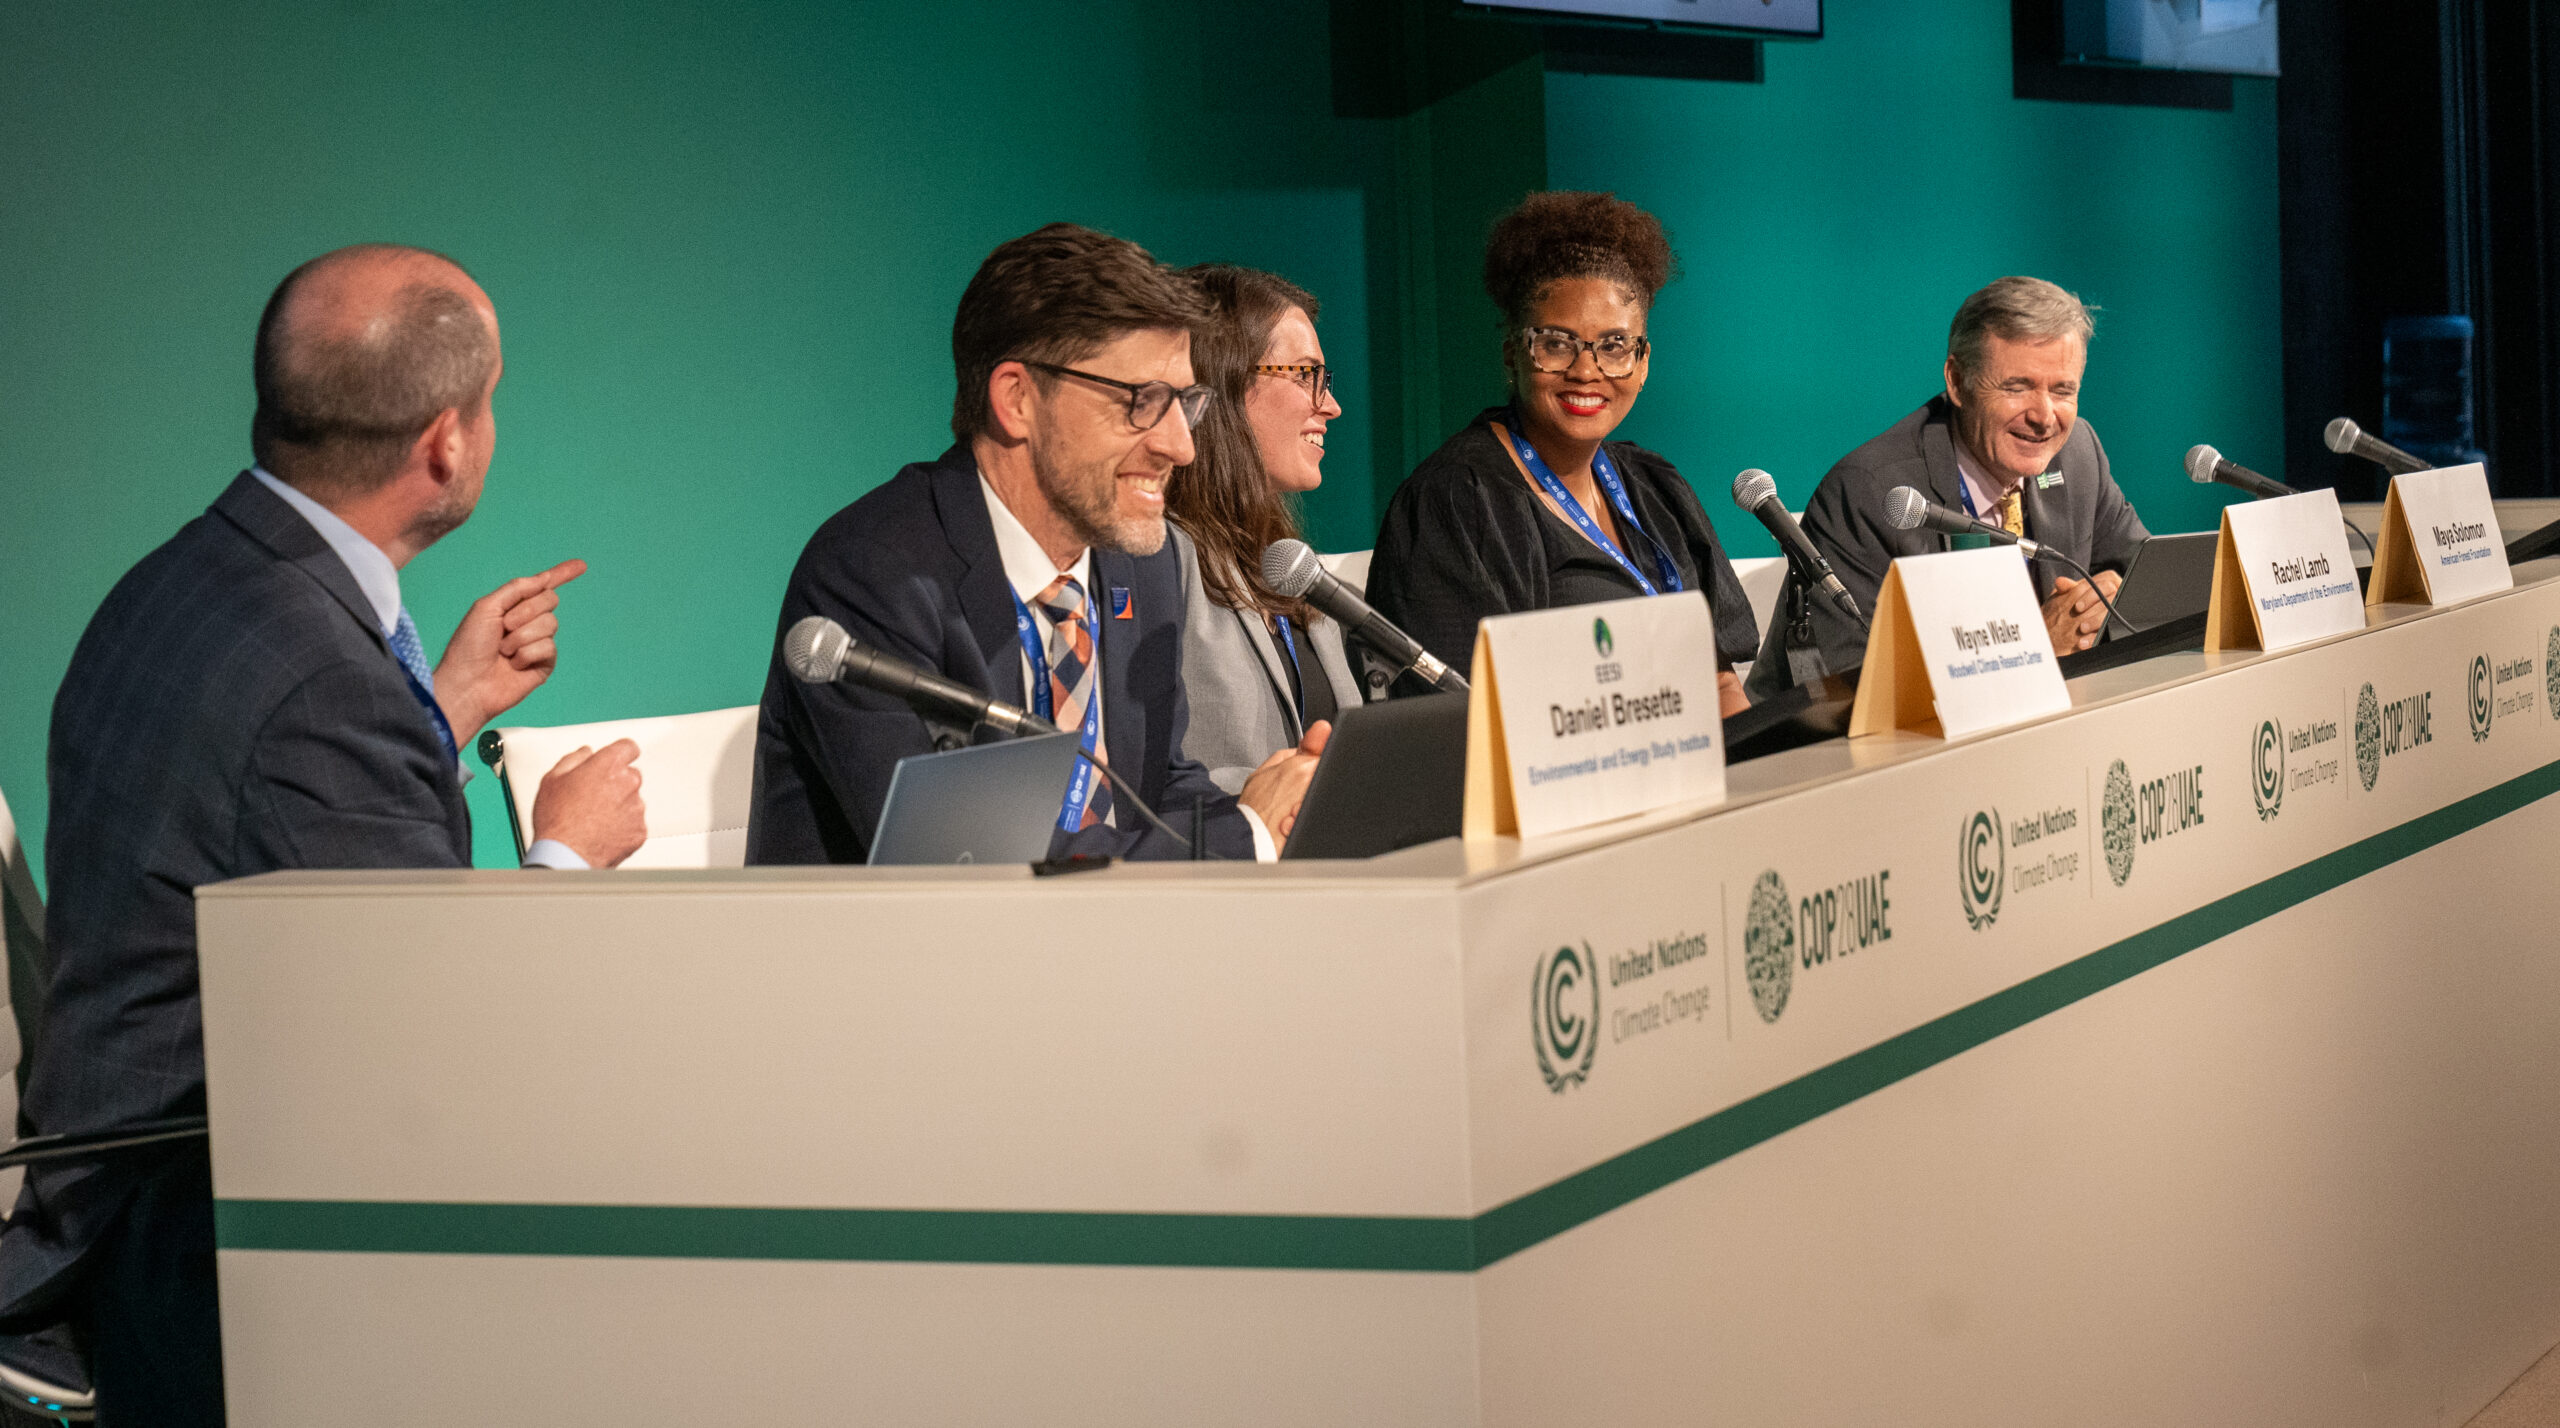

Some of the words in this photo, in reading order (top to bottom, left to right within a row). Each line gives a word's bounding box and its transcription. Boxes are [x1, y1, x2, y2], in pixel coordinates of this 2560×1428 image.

[2432, 526, 2455, 550] Maya
[2452, 521, 2487, 543] Solomon
[2272, 557, 2304, 585] Rachel
[2301, 552, 2330, 579] Lamb
[2261, 595, 2284, 612] Maryland
[2282, 591, 2310, 608] Department
[2322, 580, 2355, 598] Environment
[1952, 625, 1990, 655] Wayne
[1986, 619, 2021, 645] Walker
[2496, 660, 2512, 685] United
[2513, 656, 2533, 679] Nations
[1550, 696, 1609, 738] Daniel
[1611, 686, 1682, 725] Bresette
[2383, 691, 2432, 757] COP28UAE
[2496, 698, 2515, 718] Climate
[2516, 691, 2533, 713] Change
[2289, 724, 2311, 753] United
[2312, 719, 2337, 745] Nations
[2290, 766, 2314, 792] Climate
[2314, 760, 2338, 784] Change
[2139, 764, 2205, 845] COP28UAE
[2010, 811, 2041, 849] United
[2043, 805, 2077, 838] Nations
[2012, 862, 2046, 894] Climate
[2046, 851, 2079, 882] Change
[1800, 869, 1892, 970] COP28UAE
[1608, 942, 1654, 988] United
[1657, 931, 1708, 971] Nations
[1610, 1003, 1662, 1044] Climate
[1662, 984, 1710, 1022] Change
